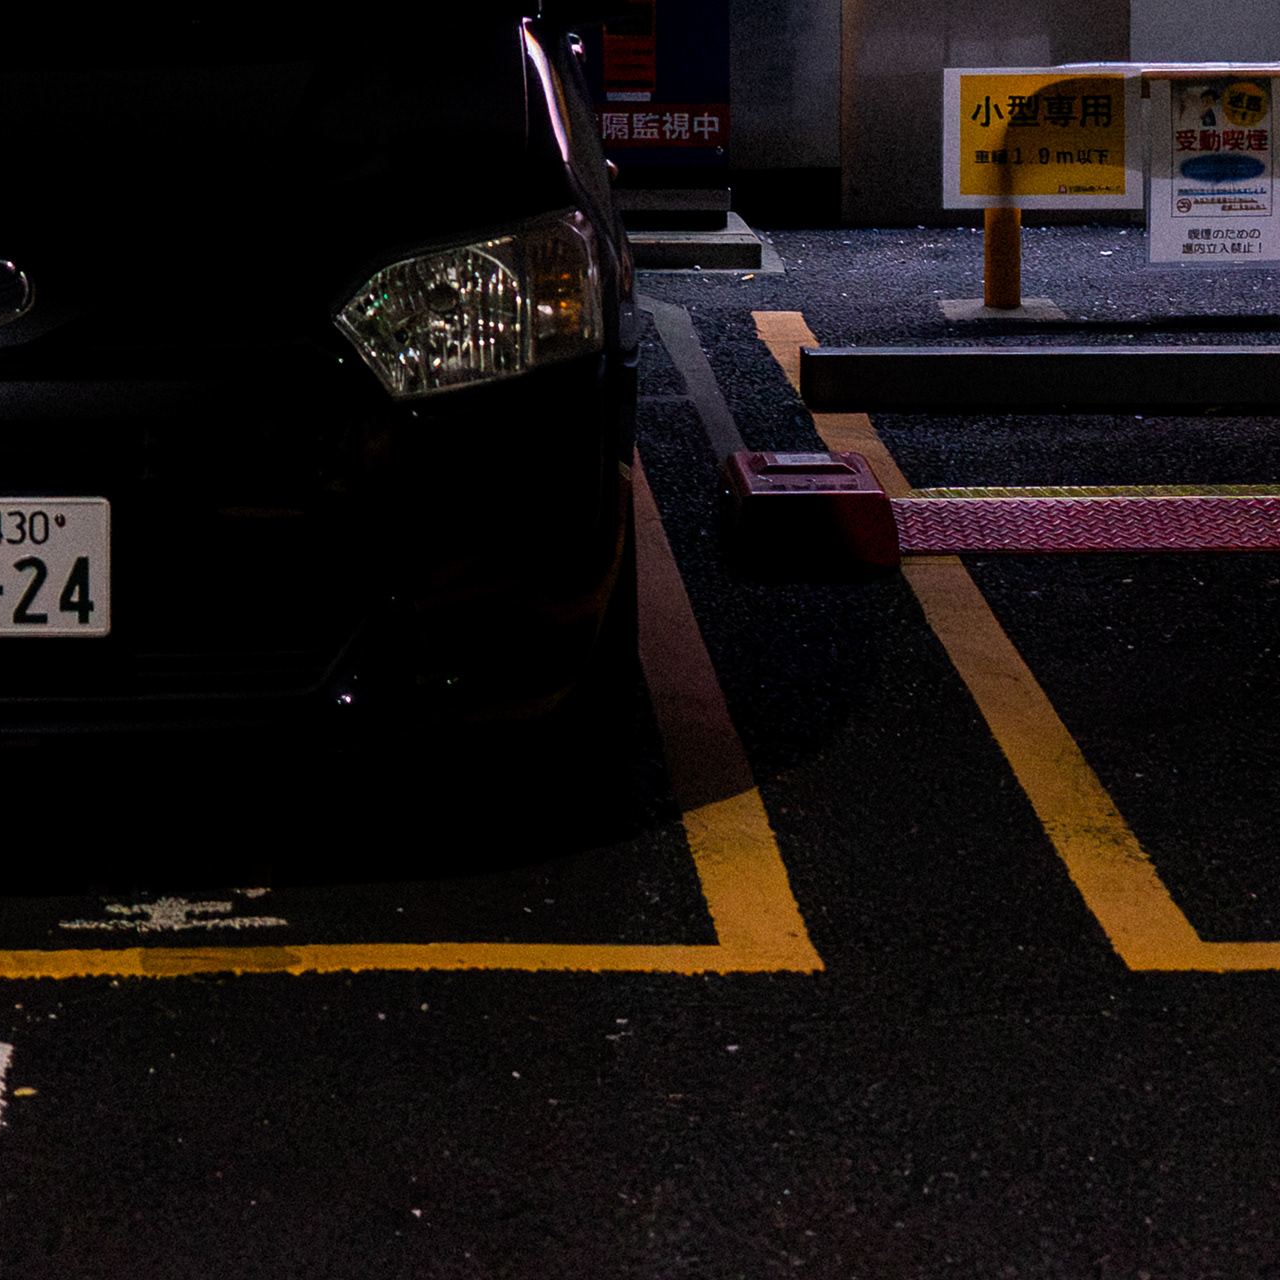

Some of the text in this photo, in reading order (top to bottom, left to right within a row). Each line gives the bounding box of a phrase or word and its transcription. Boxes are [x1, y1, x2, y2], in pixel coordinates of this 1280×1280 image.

[972, 95, 1113, 128] 小型専用
[595, 112, 720, 140] 隔監視中
[1175, 129, 1269, 152] 受動喫煙
[1187, 228, 1261, 241] 喫煙のための
